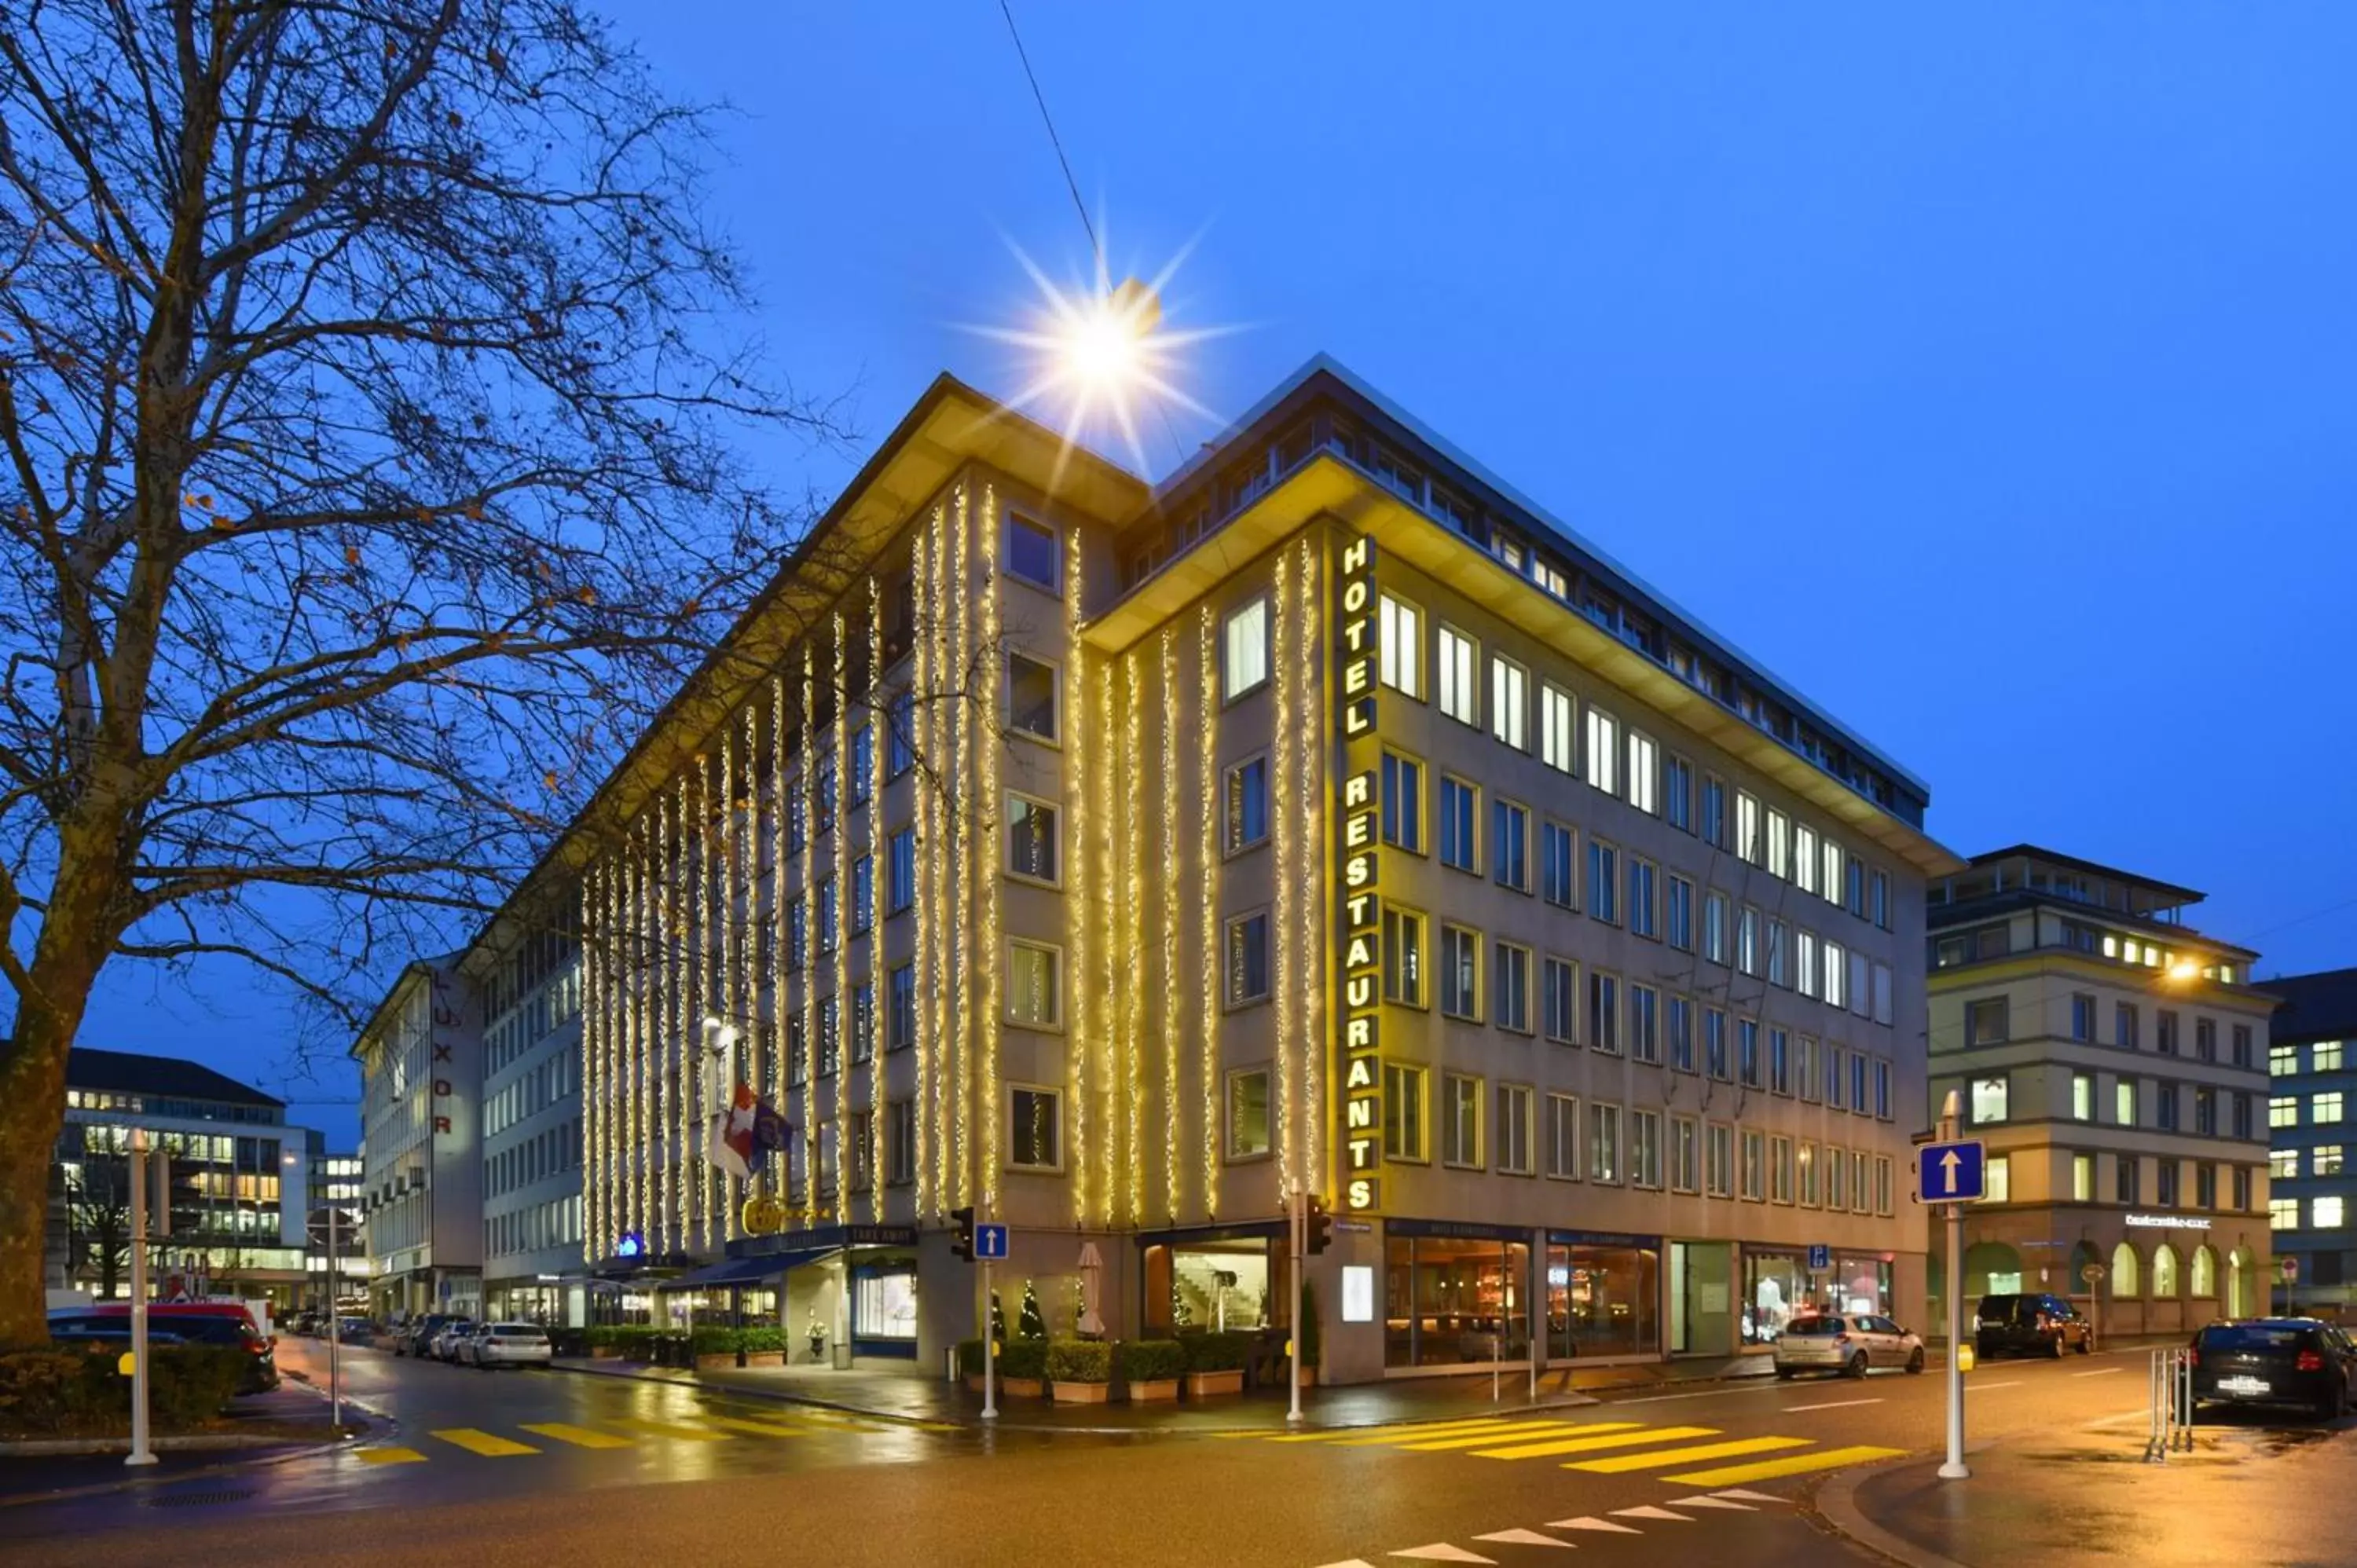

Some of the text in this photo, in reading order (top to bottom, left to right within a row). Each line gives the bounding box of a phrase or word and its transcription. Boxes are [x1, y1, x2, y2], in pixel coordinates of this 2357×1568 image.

[1344, 537, 1369, 735] HOTEL
[433, 970, 452, 1134] LUXOR
[1346, 775, 1371, 1209] RESTAURANTS
